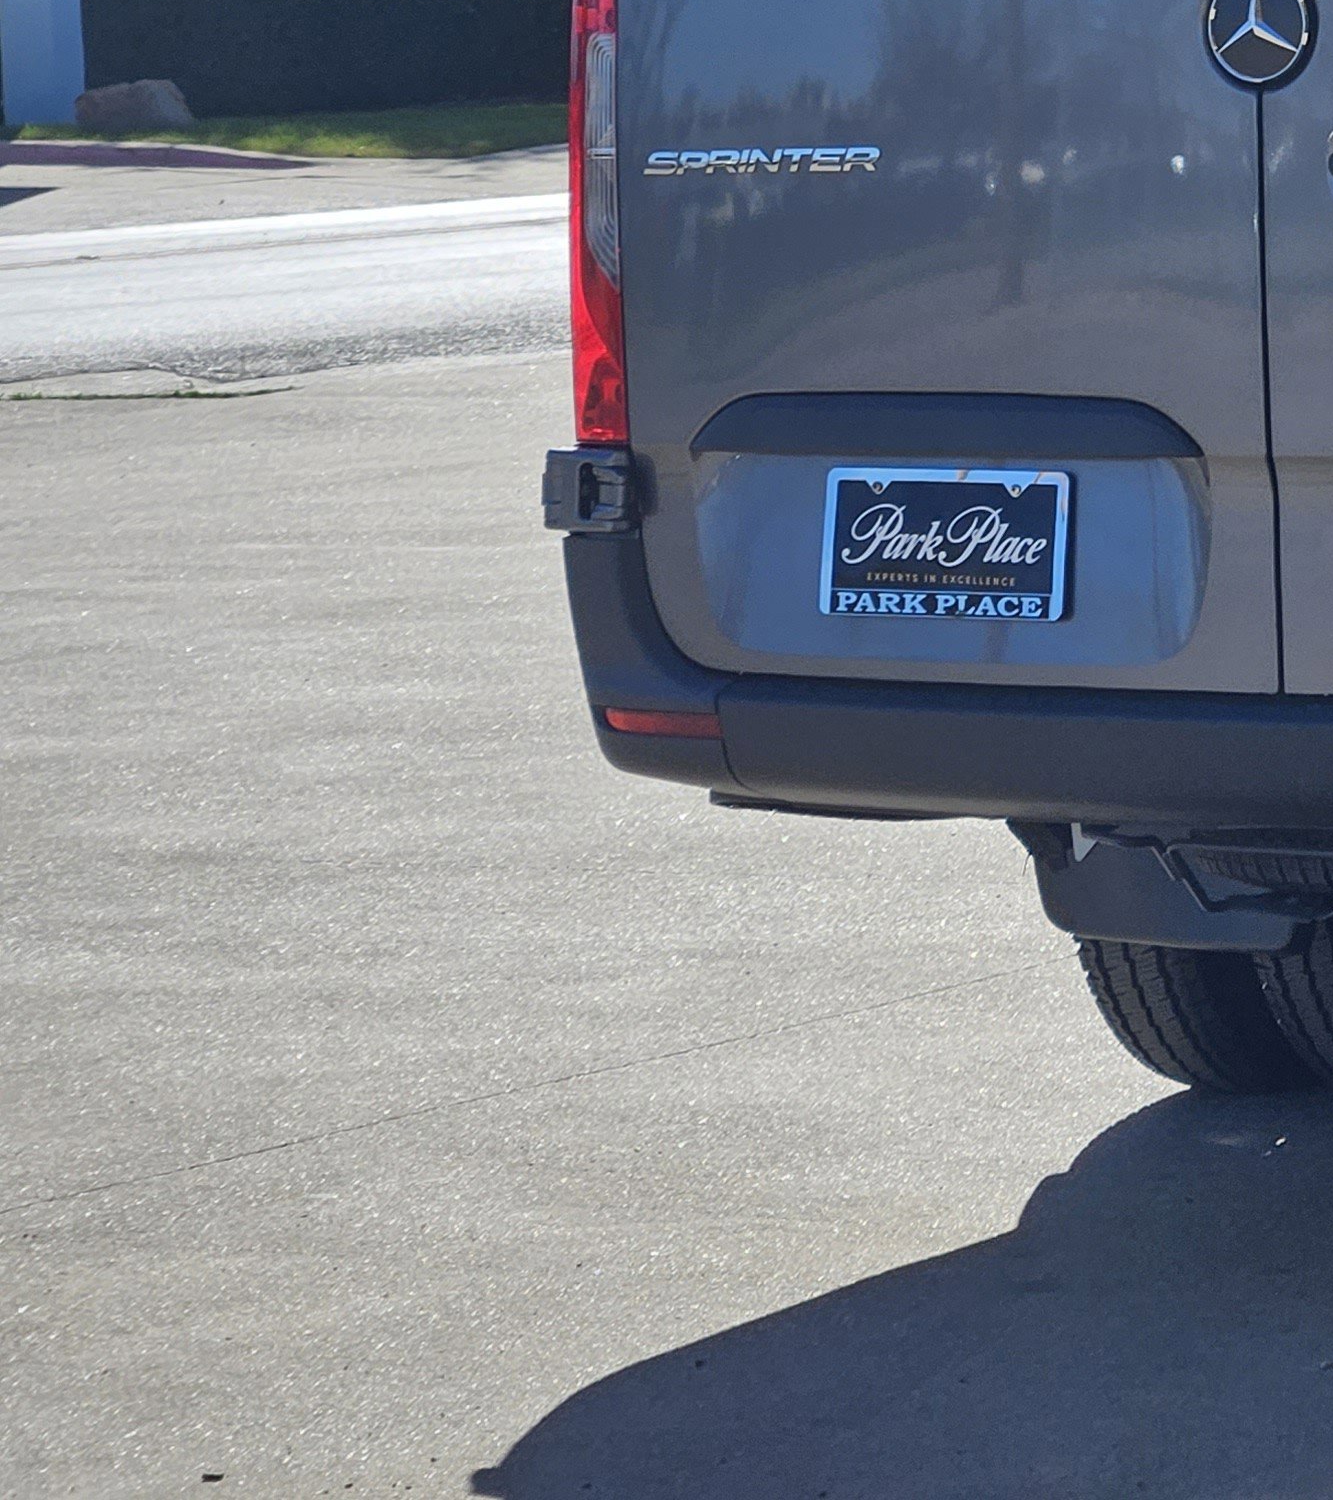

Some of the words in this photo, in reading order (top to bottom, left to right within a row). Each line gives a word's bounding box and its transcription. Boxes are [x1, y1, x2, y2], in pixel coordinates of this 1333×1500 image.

[643, 147, 880, 175] SPRINTER
[841, 503, 943, 564] Park
[938, 505, 1047, 567] Place
[866, 572, 919, 583] EXPERTS
[924, 574, 937, 583] IN
[942, 574, 1016, 587] EXCELLENCE
[835, 591, 928, 614] PARK
[934, 594, 1043, 618] PLACE
